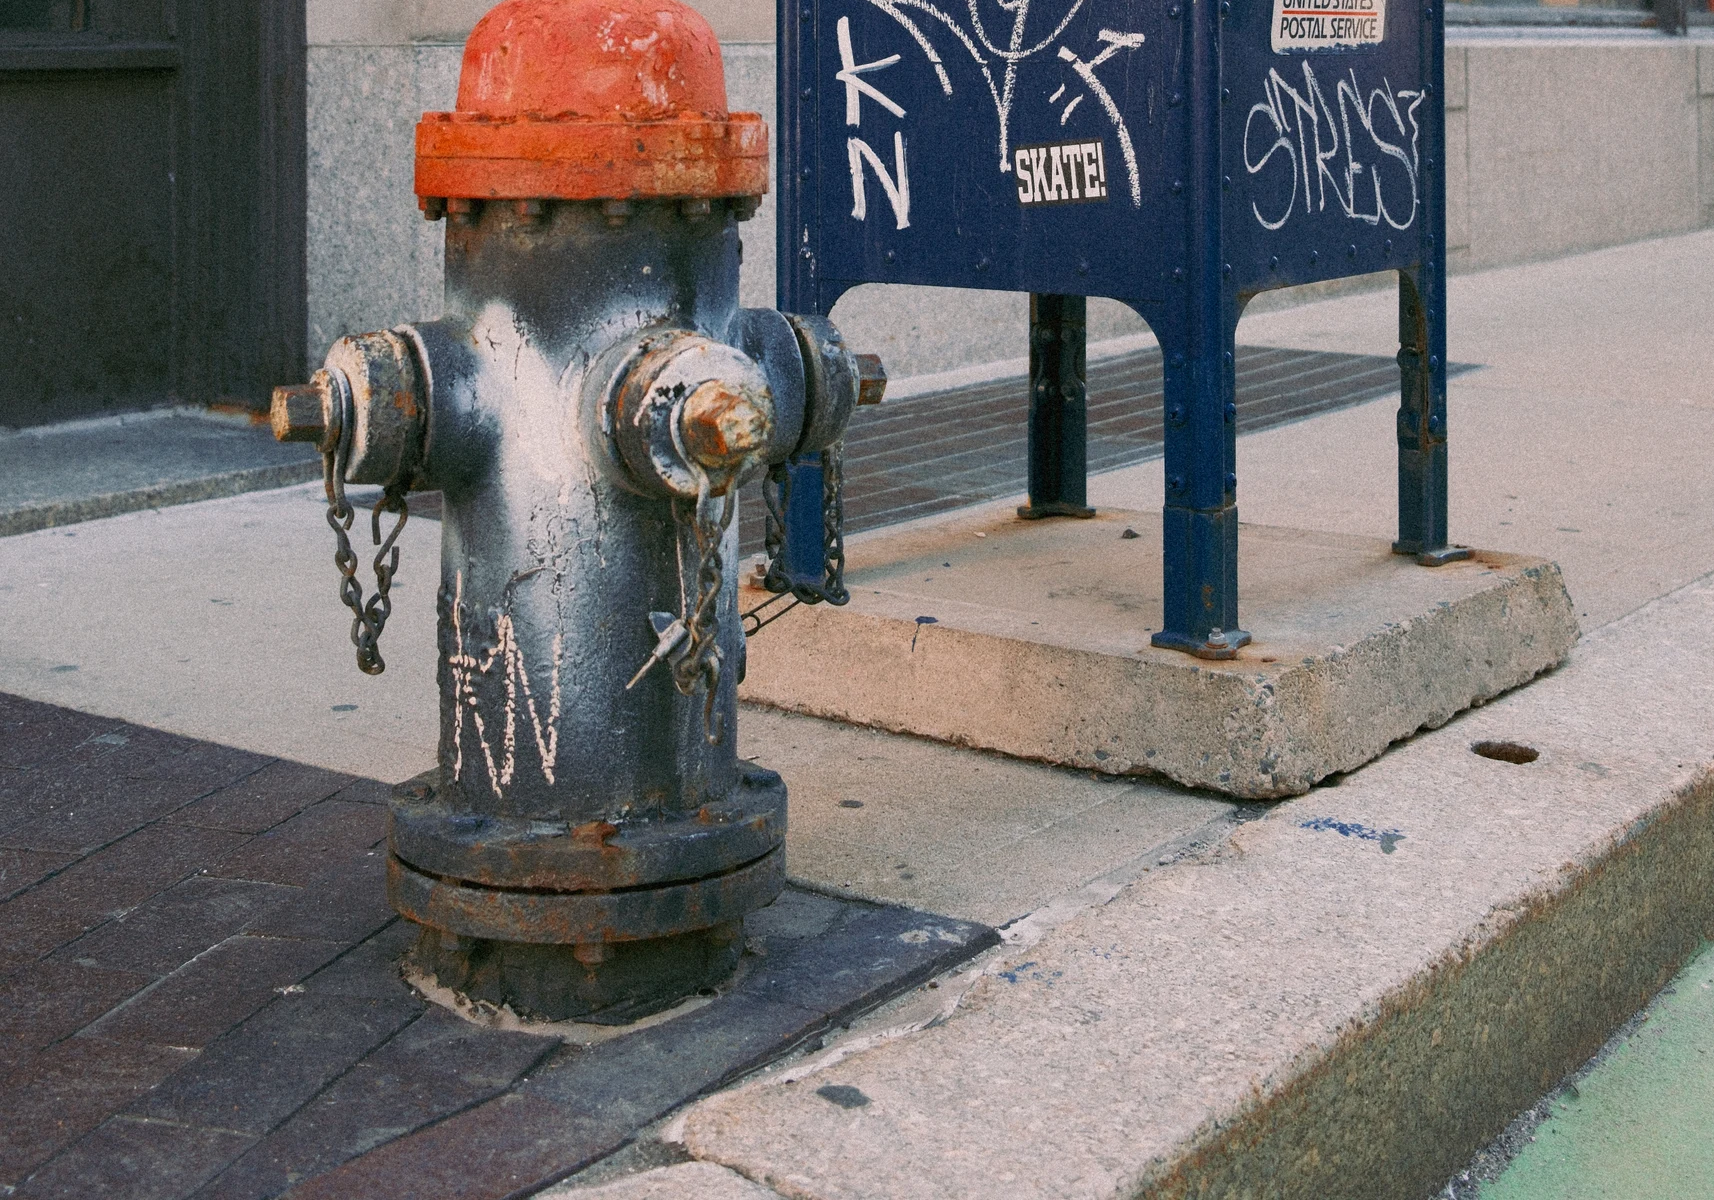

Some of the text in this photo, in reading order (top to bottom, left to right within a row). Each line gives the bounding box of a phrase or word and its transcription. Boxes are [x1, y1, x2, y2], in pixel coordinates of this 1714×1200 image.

[1280, 16, 1377, 39] POSTAL SERVICE
[1015, 142, 1106, 203] SKATE!
